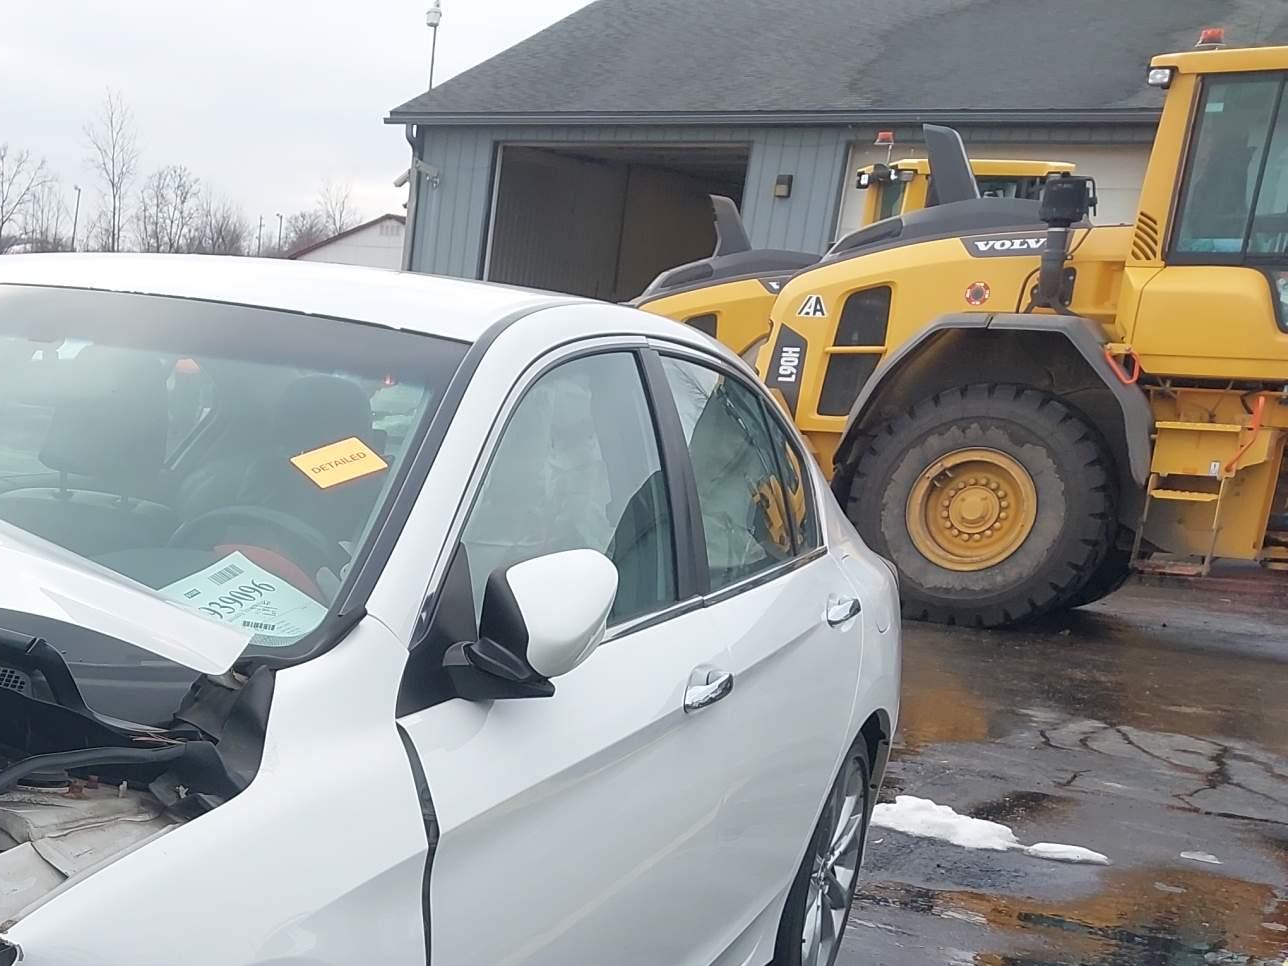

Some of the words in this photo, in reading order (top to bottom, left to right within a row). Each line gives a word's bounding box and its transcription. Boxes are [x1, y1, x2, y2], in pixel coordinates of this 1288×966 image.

[974, 238, 1047, 251] VOLV
[777, 346, 801, 382] L90H
[311, 451, 367, 474] DETAILED
